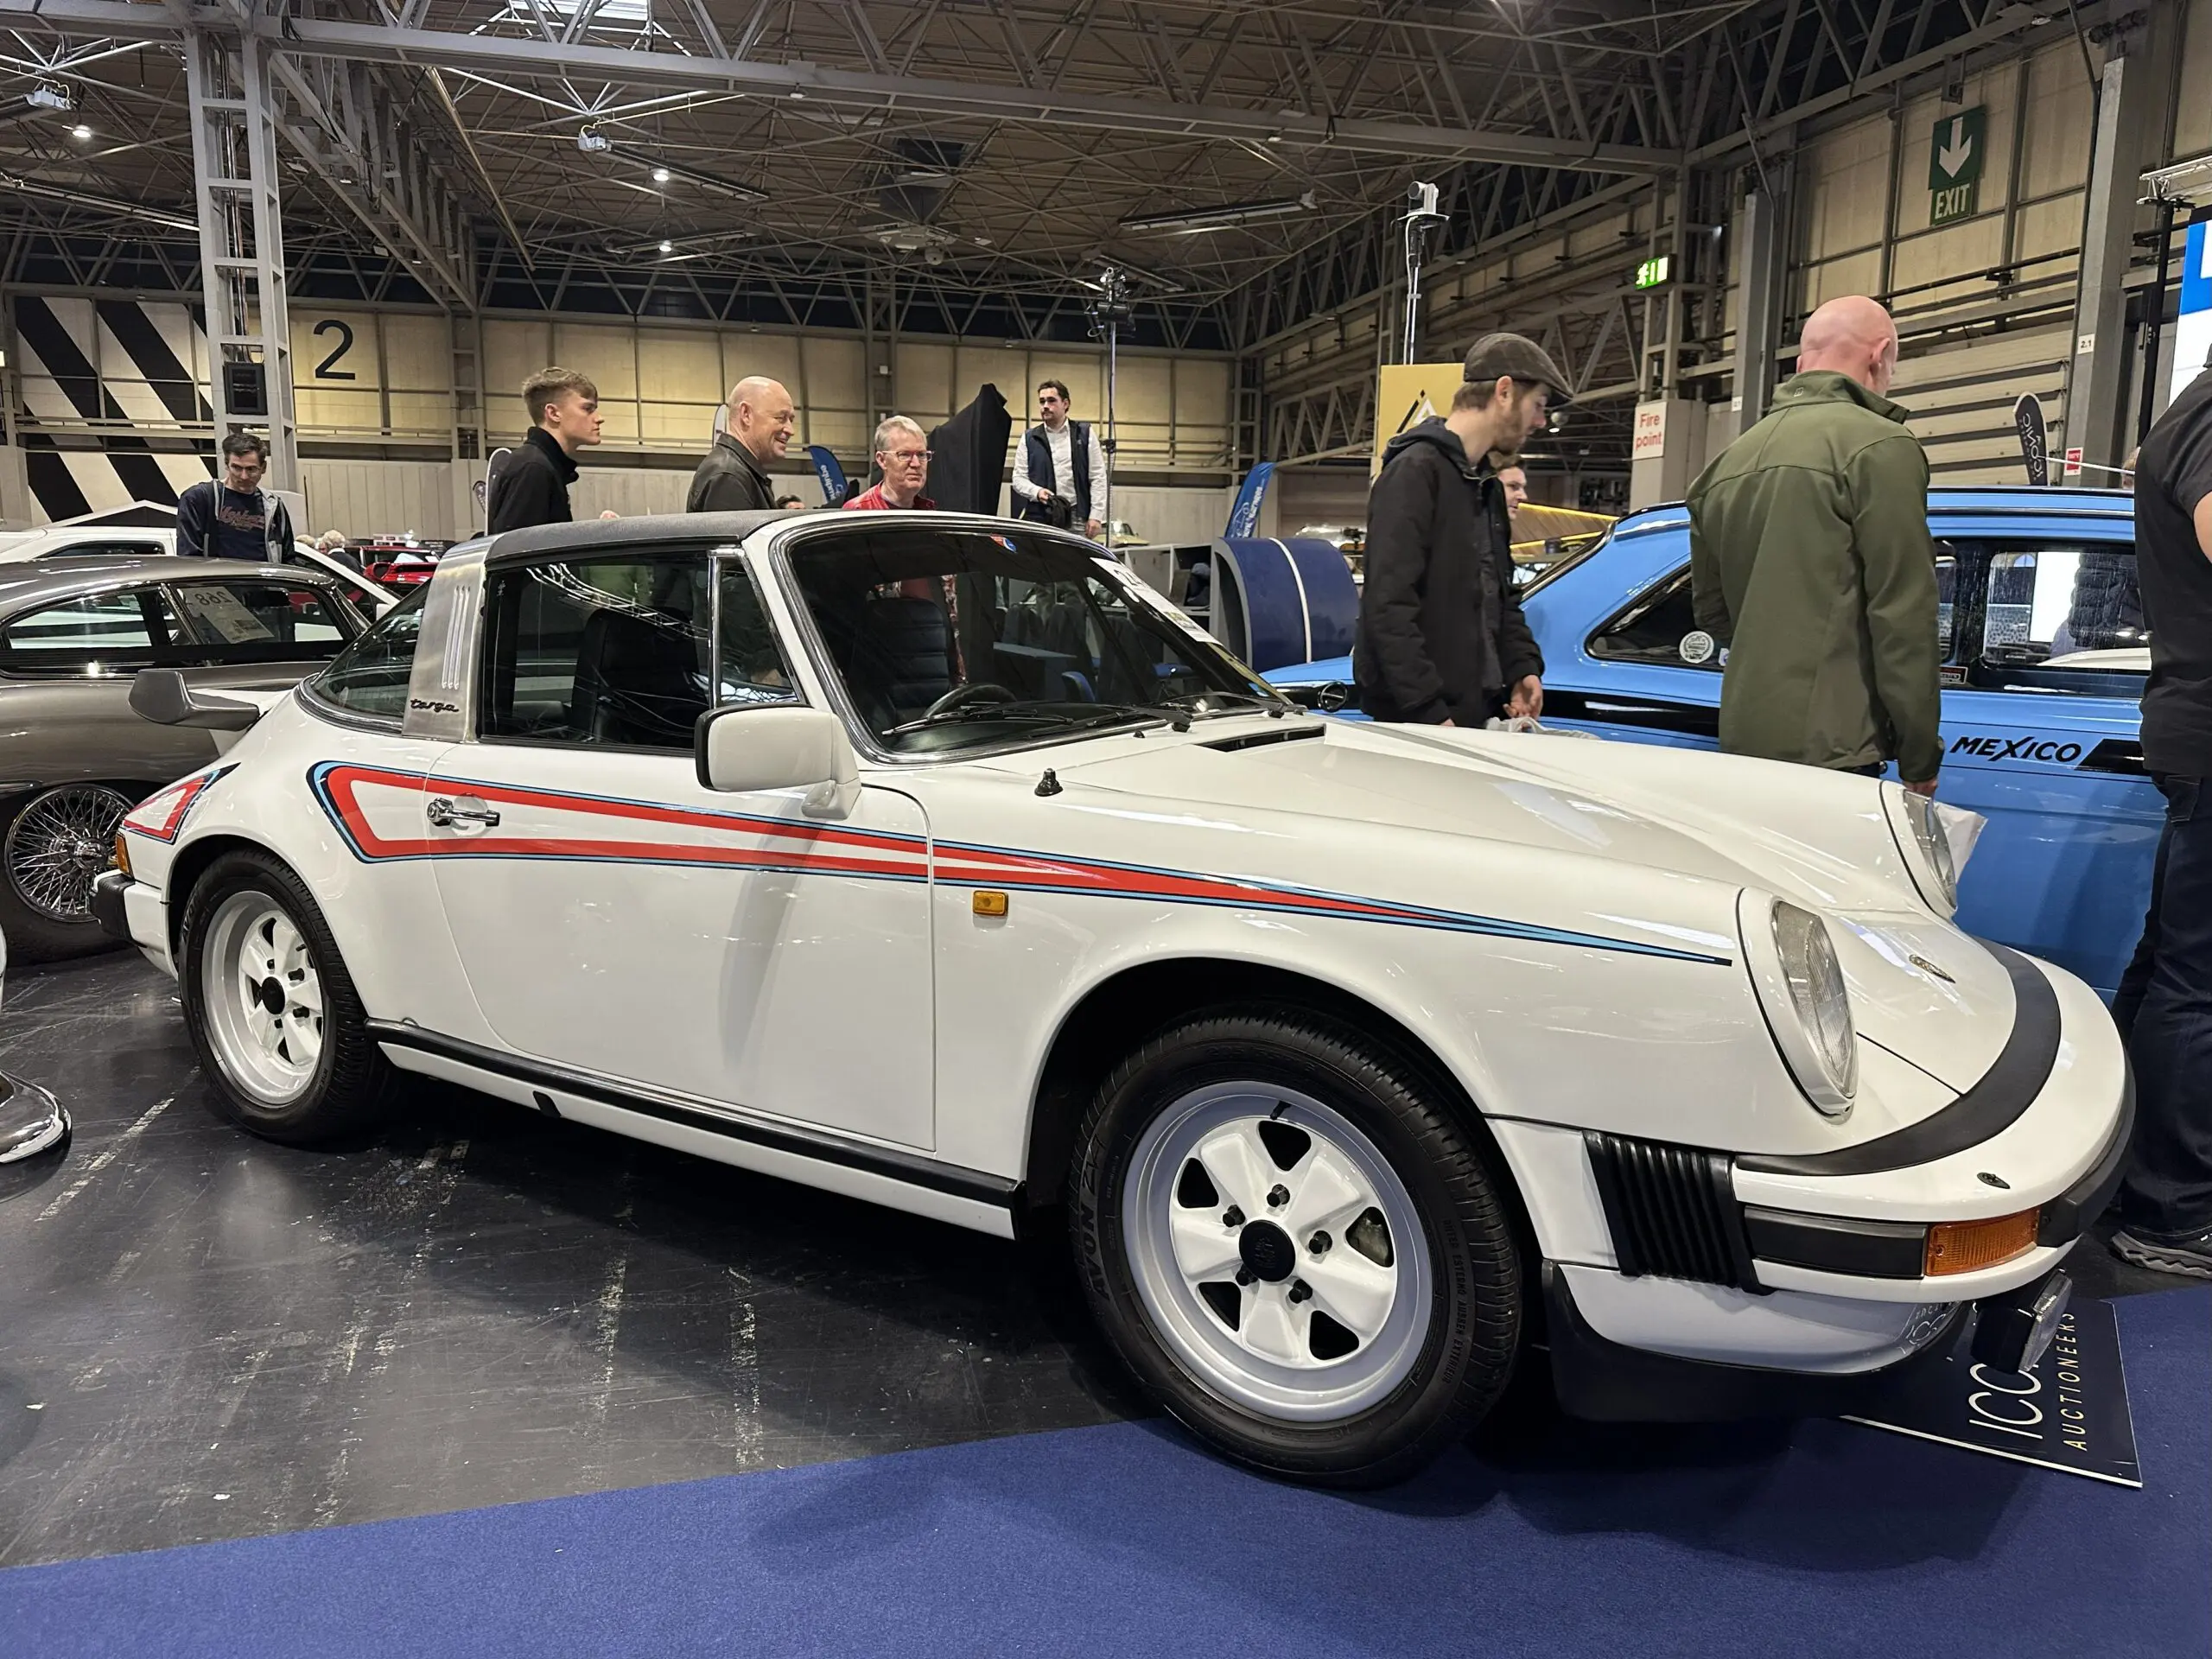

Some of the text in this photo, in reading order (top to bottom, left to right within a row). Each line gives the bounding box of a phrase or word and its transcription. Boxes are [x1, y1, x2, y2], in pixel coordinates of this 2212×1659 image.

[1935, 183, 1970, 219] EXIT
[314, 320, 356, 380] 2
[1639, 413, 1660, 428] Fire
[1635, 431, 1662, 451] point
[2022, 413, 2044, 478] ICONIC
[410, 699, 459, 713] targa
[1949, 736, 2082, 762] MEXICO
[1080, 1202, 1109, 1301] AVON
[1442, 1339, 1464, 1384] EXTERIEUR
[2056, 1313, 2088, 1451] AUCTIONEERS
